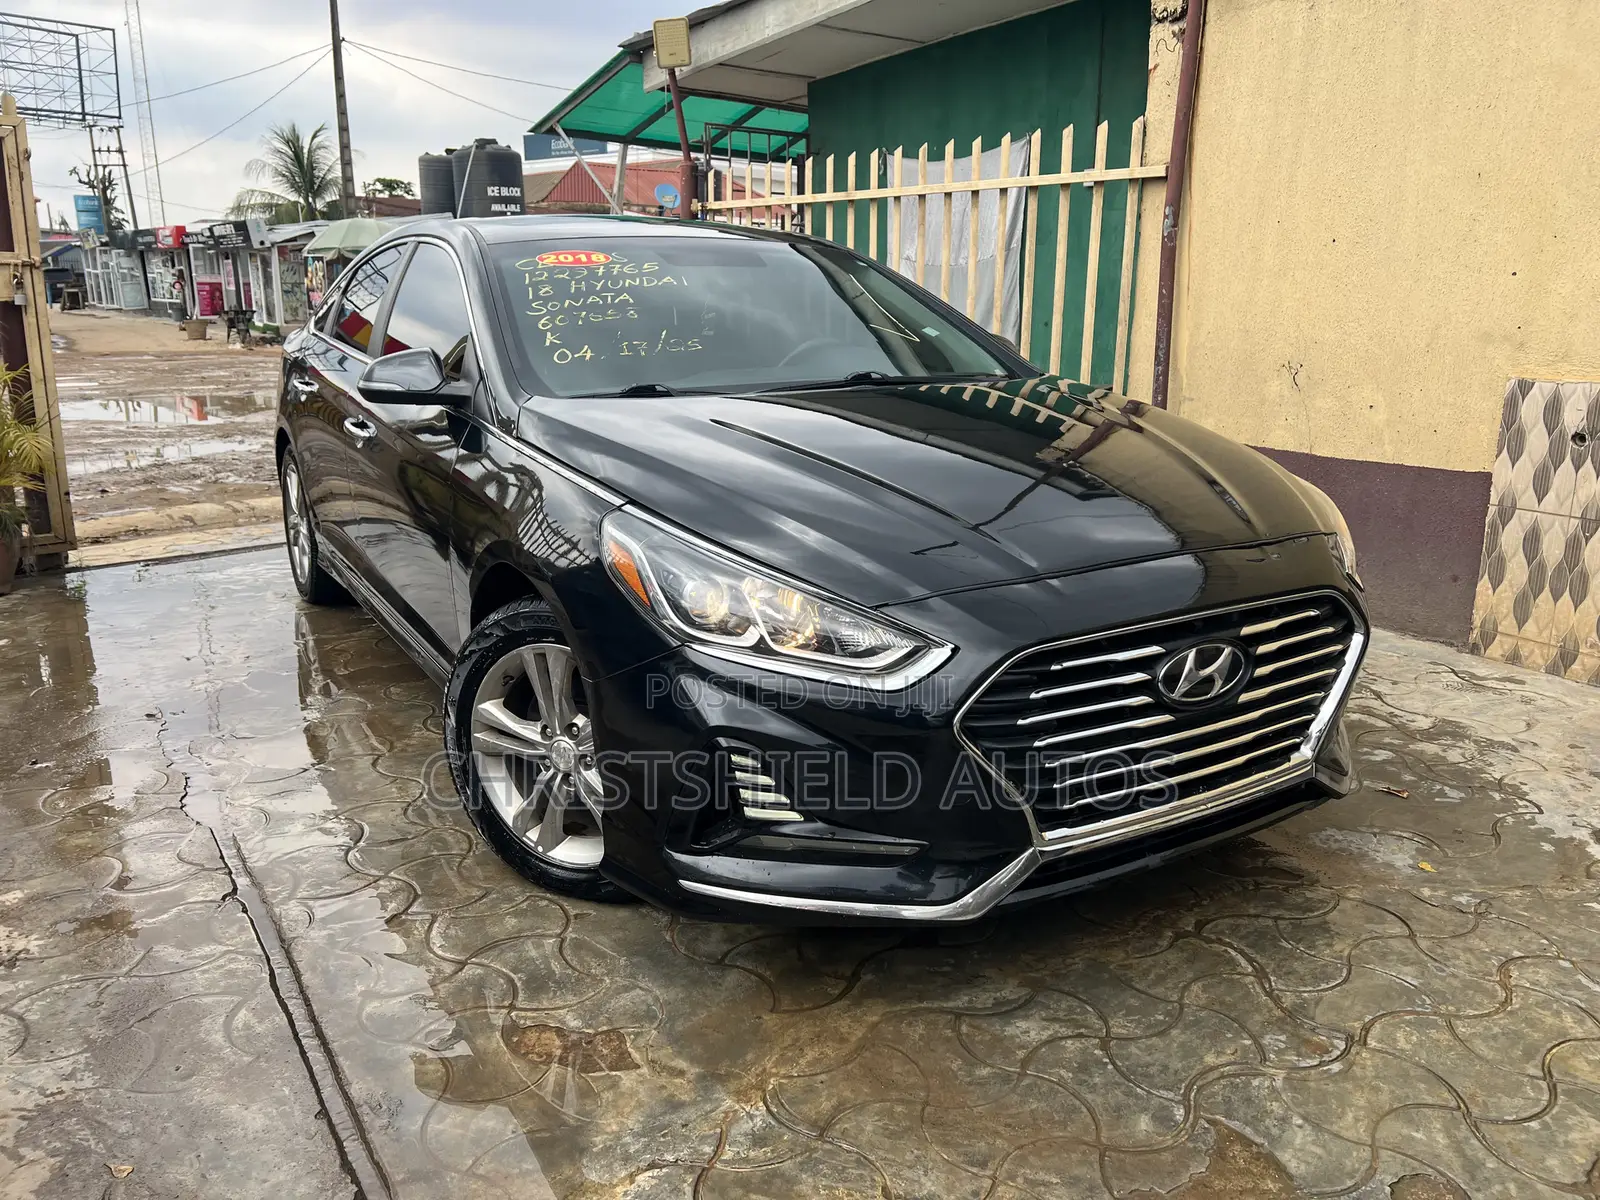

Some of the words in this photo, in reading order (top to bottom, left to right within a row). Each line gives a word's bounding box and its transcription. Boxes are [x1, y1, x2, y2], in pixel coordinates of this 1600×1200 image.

[487, 186, 500, 196] ICE
[500, 186, 521, 197] BLOCK
[490, 203, 521, 212] AVAILABLE
[542, 253, 606, 263] 2018
[528, 284, 553, 300] 18
[570, 276, 687, 294] HYUNDAI
[525, 292, 635, 316] SONATA
[544, 331, 563, 347] K
